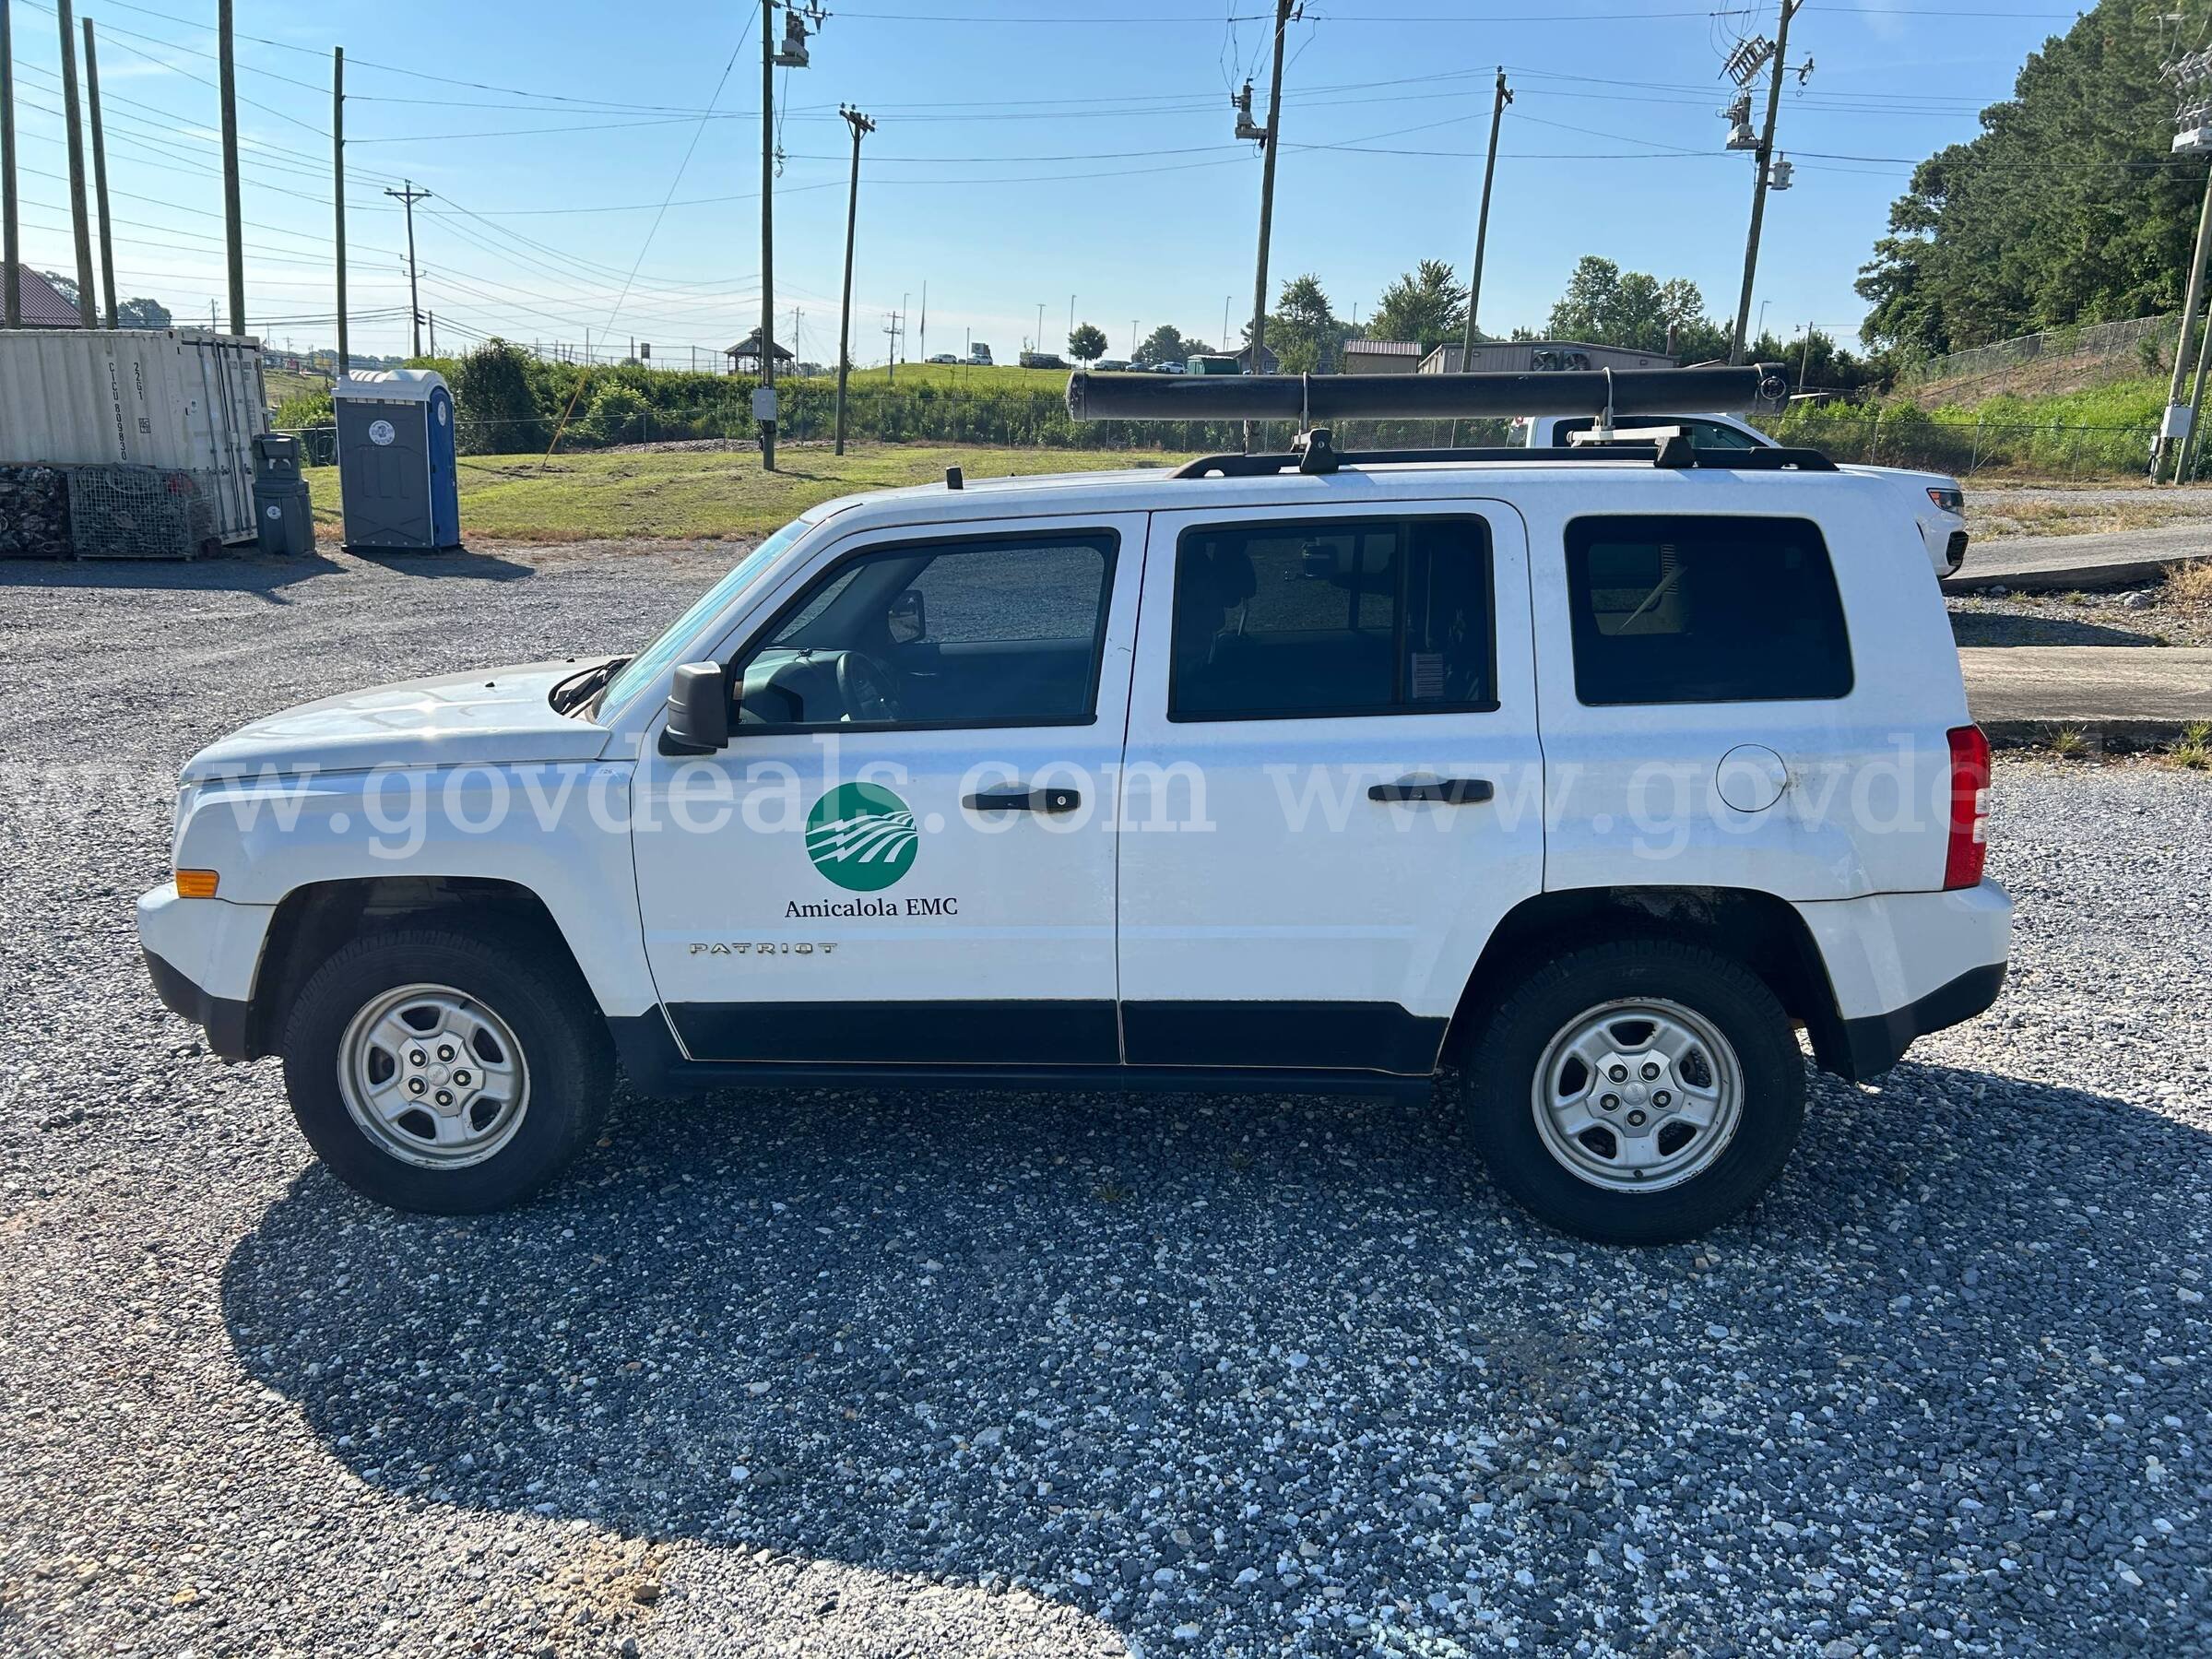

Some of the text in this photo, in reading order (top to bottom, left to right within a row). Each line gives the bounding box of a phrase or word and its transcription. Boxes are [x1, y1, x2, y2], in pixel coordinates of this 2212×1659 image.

[134, 361, 143, 400] 22G1
[784, 896, 959, 918] Amicalola EMC
[689, 942, 838, 955] PATRIOT
